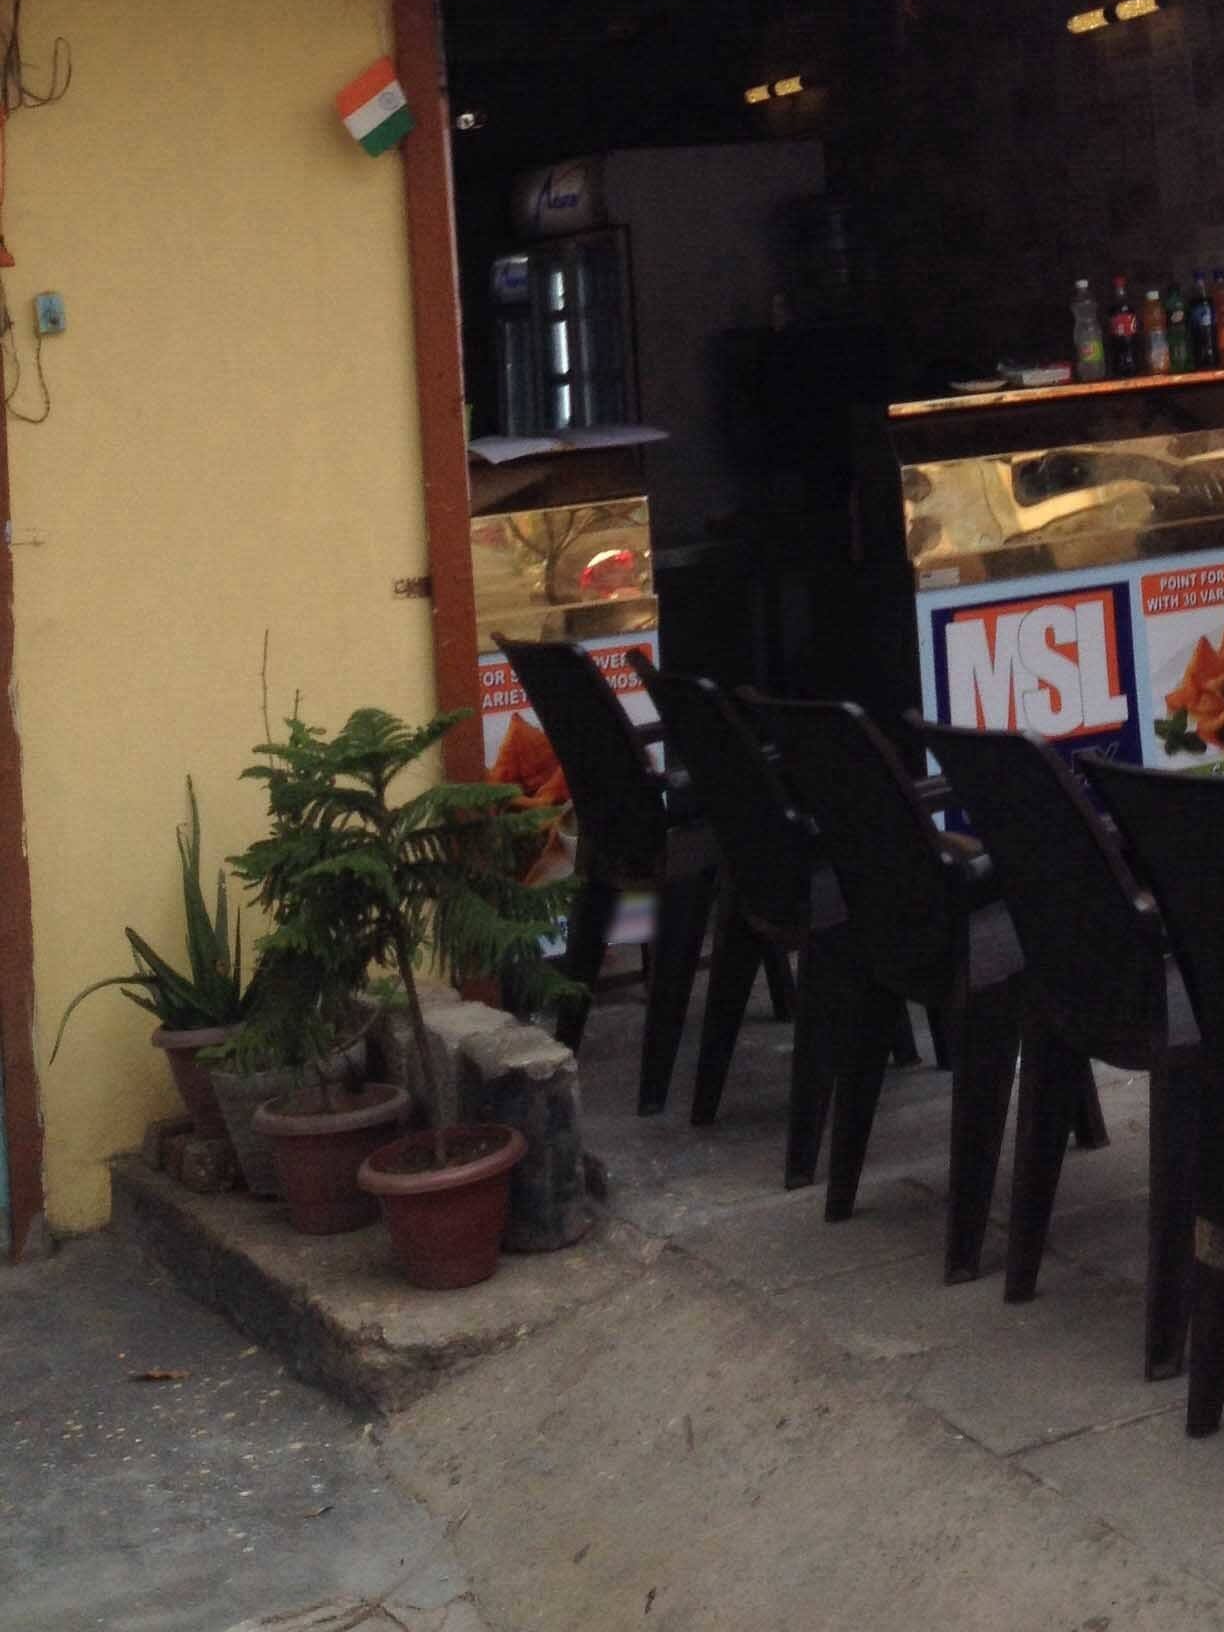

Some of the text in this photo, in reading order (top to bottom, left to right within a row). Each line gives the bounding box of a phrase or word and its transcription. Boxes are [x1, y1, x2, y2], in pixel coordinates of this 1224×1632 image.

[1160, 573, 1198, 592] POINT
[1201, 569, 1224, 585] FOR
[1147, 595, 1180, 612] WITH
[945, 599, 1129, 739] MSL
